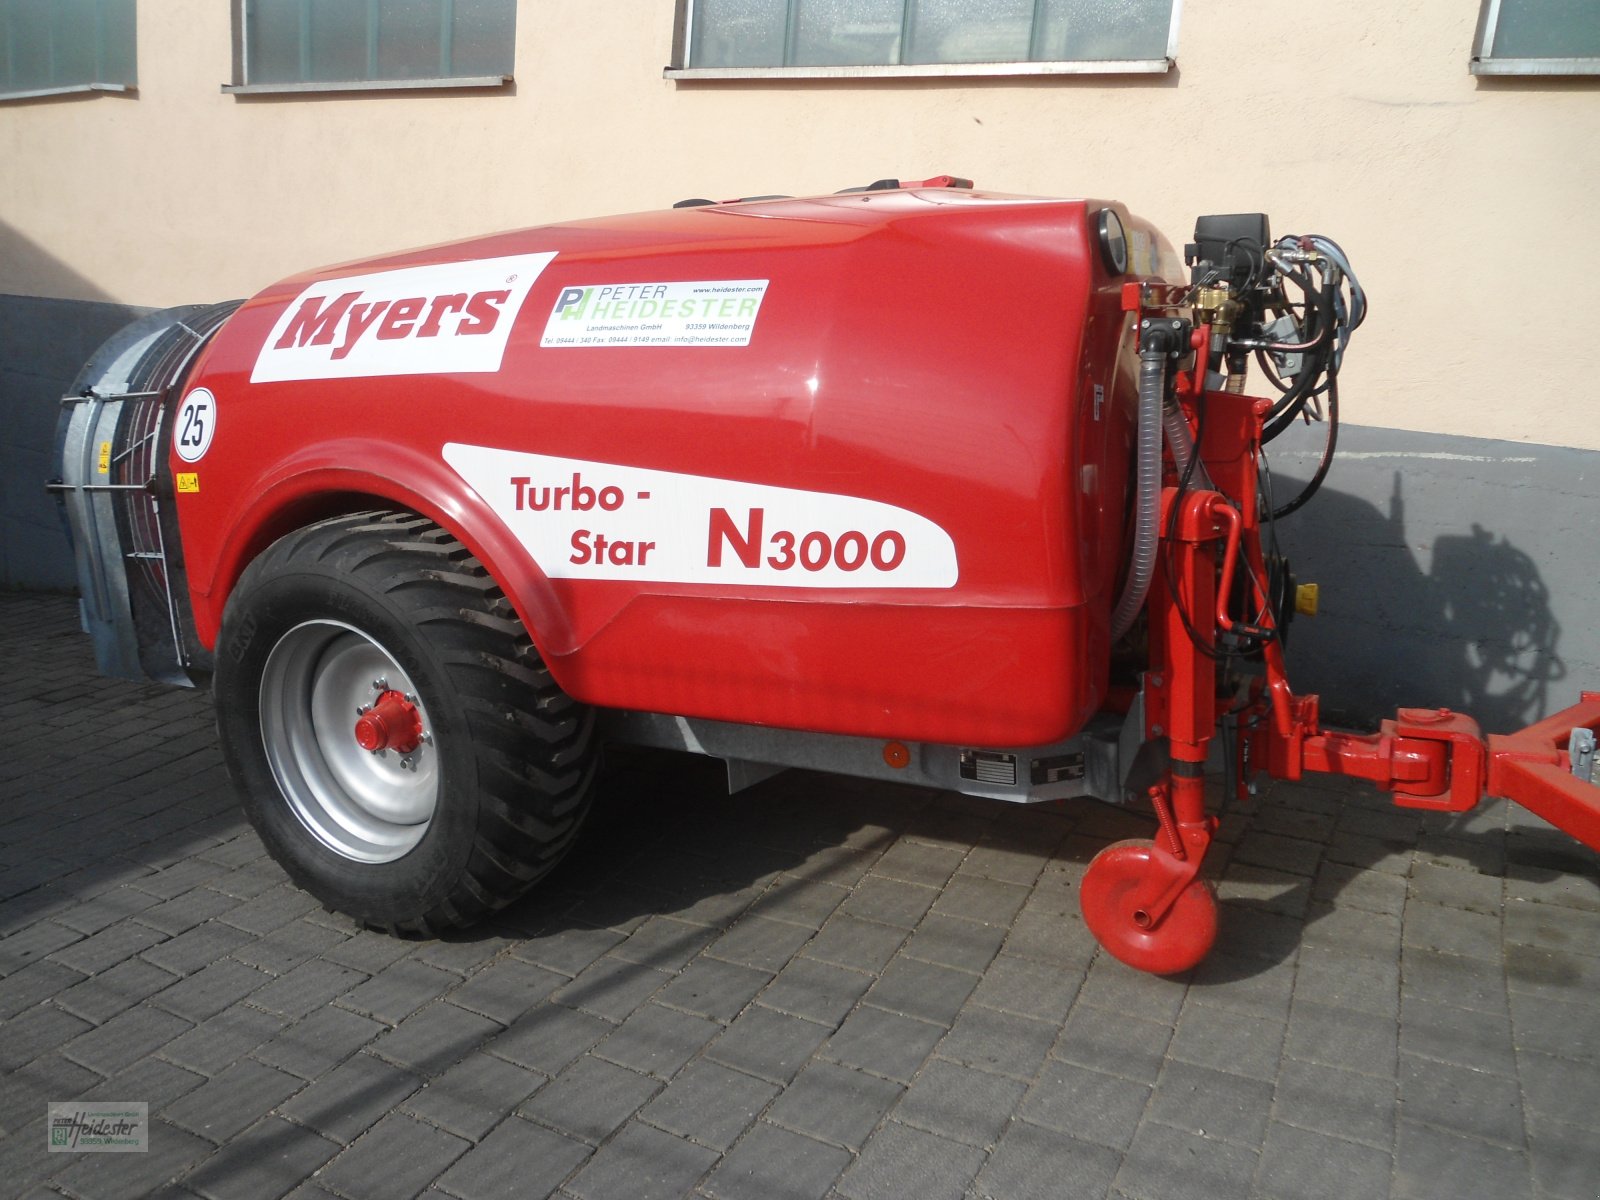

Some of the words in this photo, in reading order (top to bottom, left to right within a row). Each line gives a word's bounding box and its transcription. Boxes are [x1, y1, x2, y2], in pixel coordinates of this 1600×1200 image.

[598, 285, 668, 301] PETER
[591, 298, 758, 320] HEIDESTER
[273, 290, 512, 361] Myers
[586, 324, 639, 332] Landmaschinen
[640, 323, 662, 331] GmbH
[674, 335, 747, 344] info@heidester.com
[708, 323, 750, 331] Wildenberg
[181, 404, 207, 447] 25
[511, 473, 624, 511] Turbo
[569, 529, 656, 567] Star
[706, 507, 906, 572] N3000
